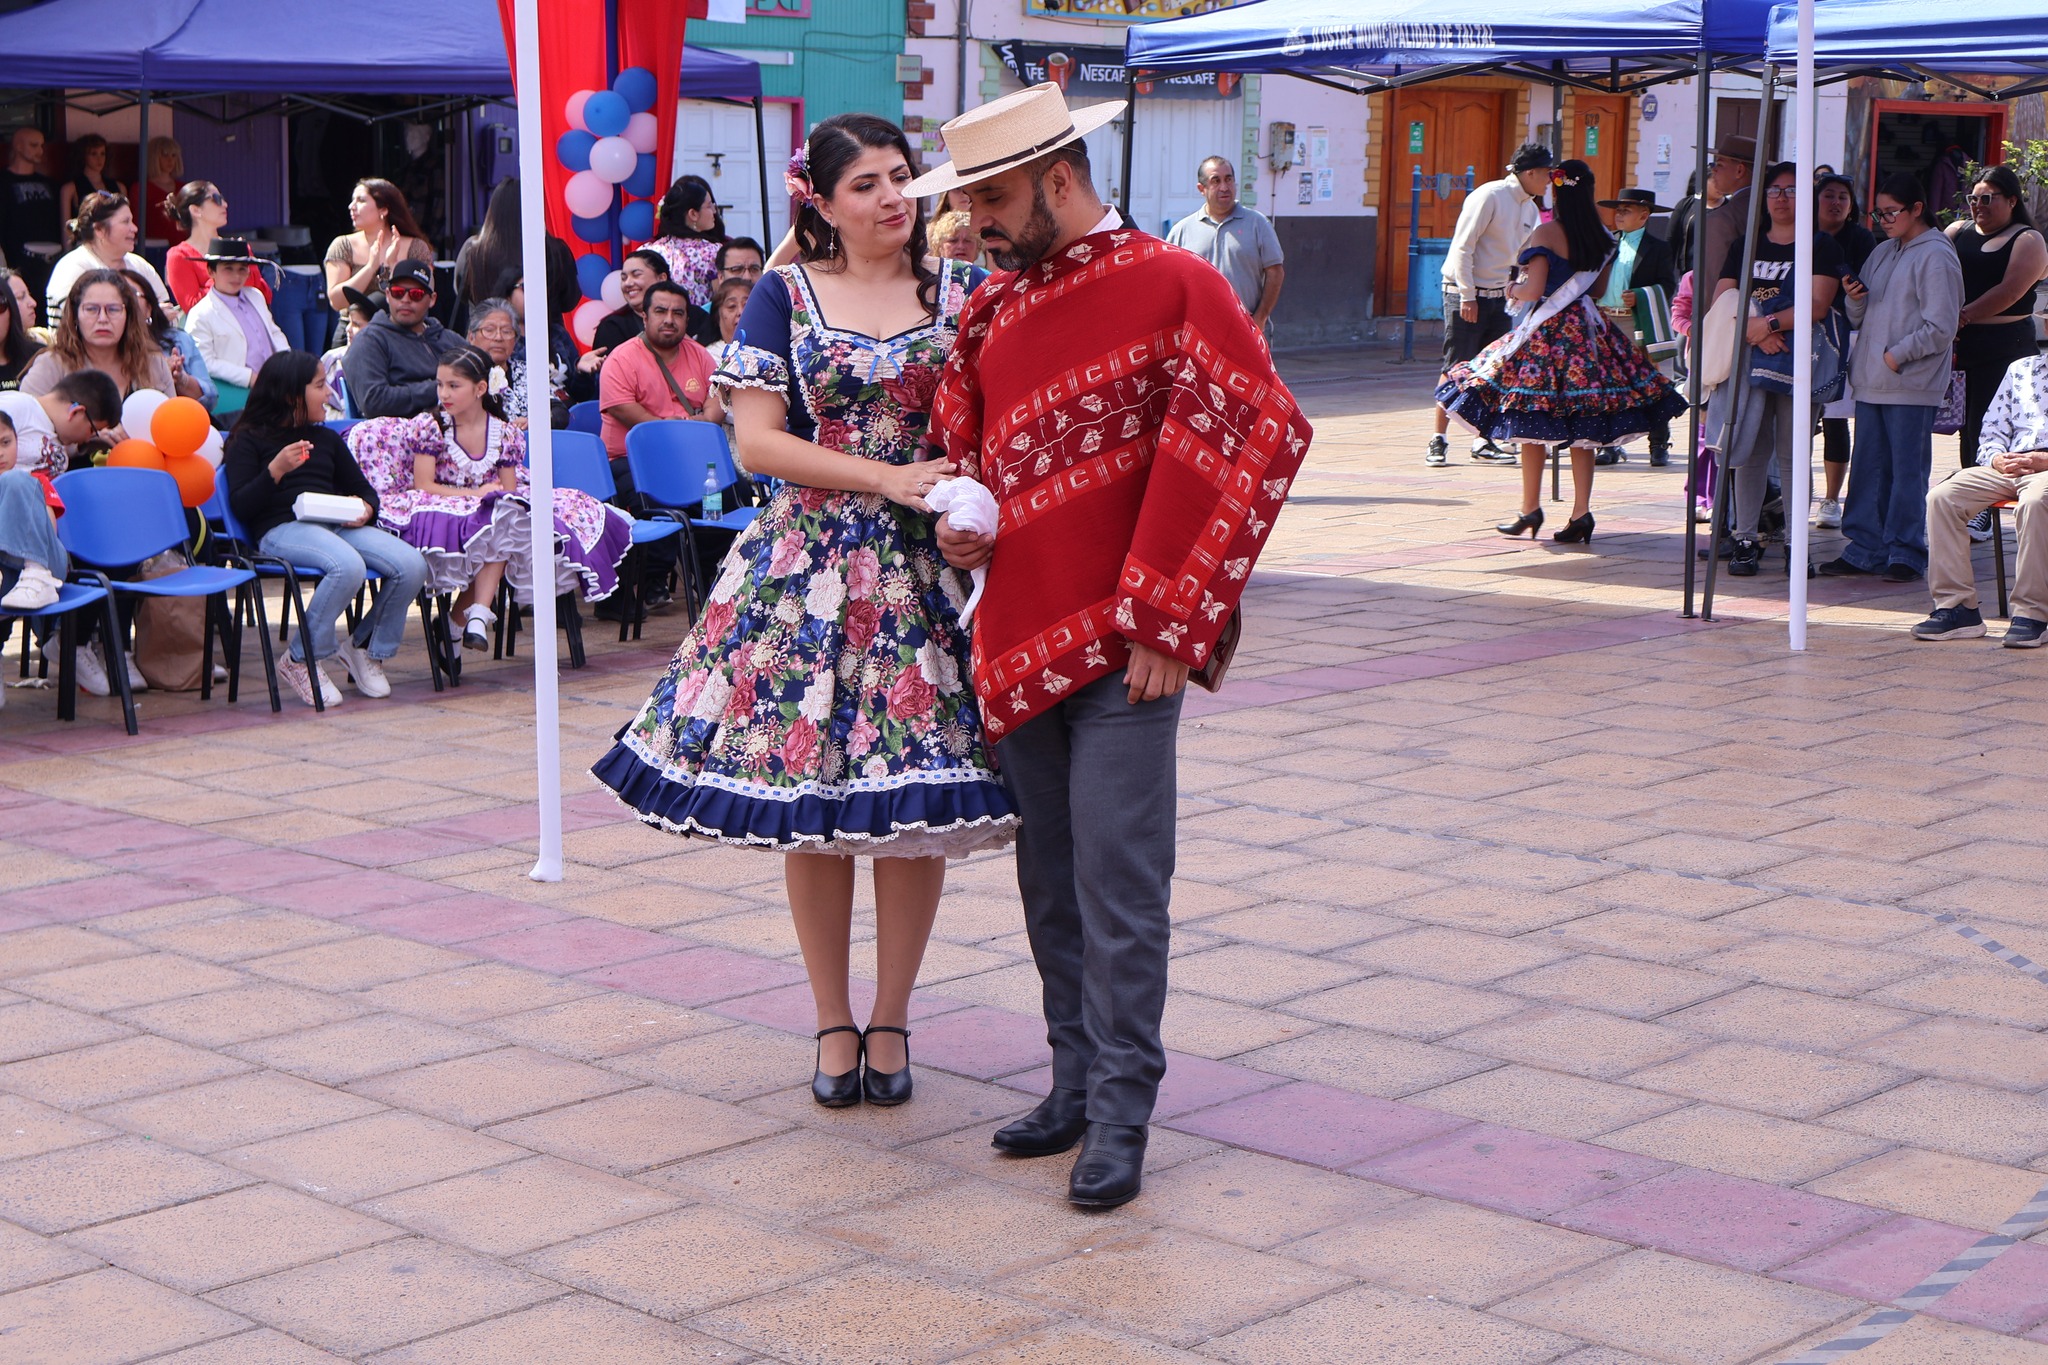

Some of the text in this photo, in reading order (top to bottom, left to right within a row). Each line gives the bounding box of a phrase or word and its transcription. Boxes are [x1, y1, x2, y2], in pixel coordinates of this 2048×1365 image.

[1355, 22, 1436, 49] MUNICIPALIDAD
[1438, 23, 1453, 49] DE
[1454, 23, 1495, 49] TALTAL
[1080, 63, 1126, 82] NESCAF
